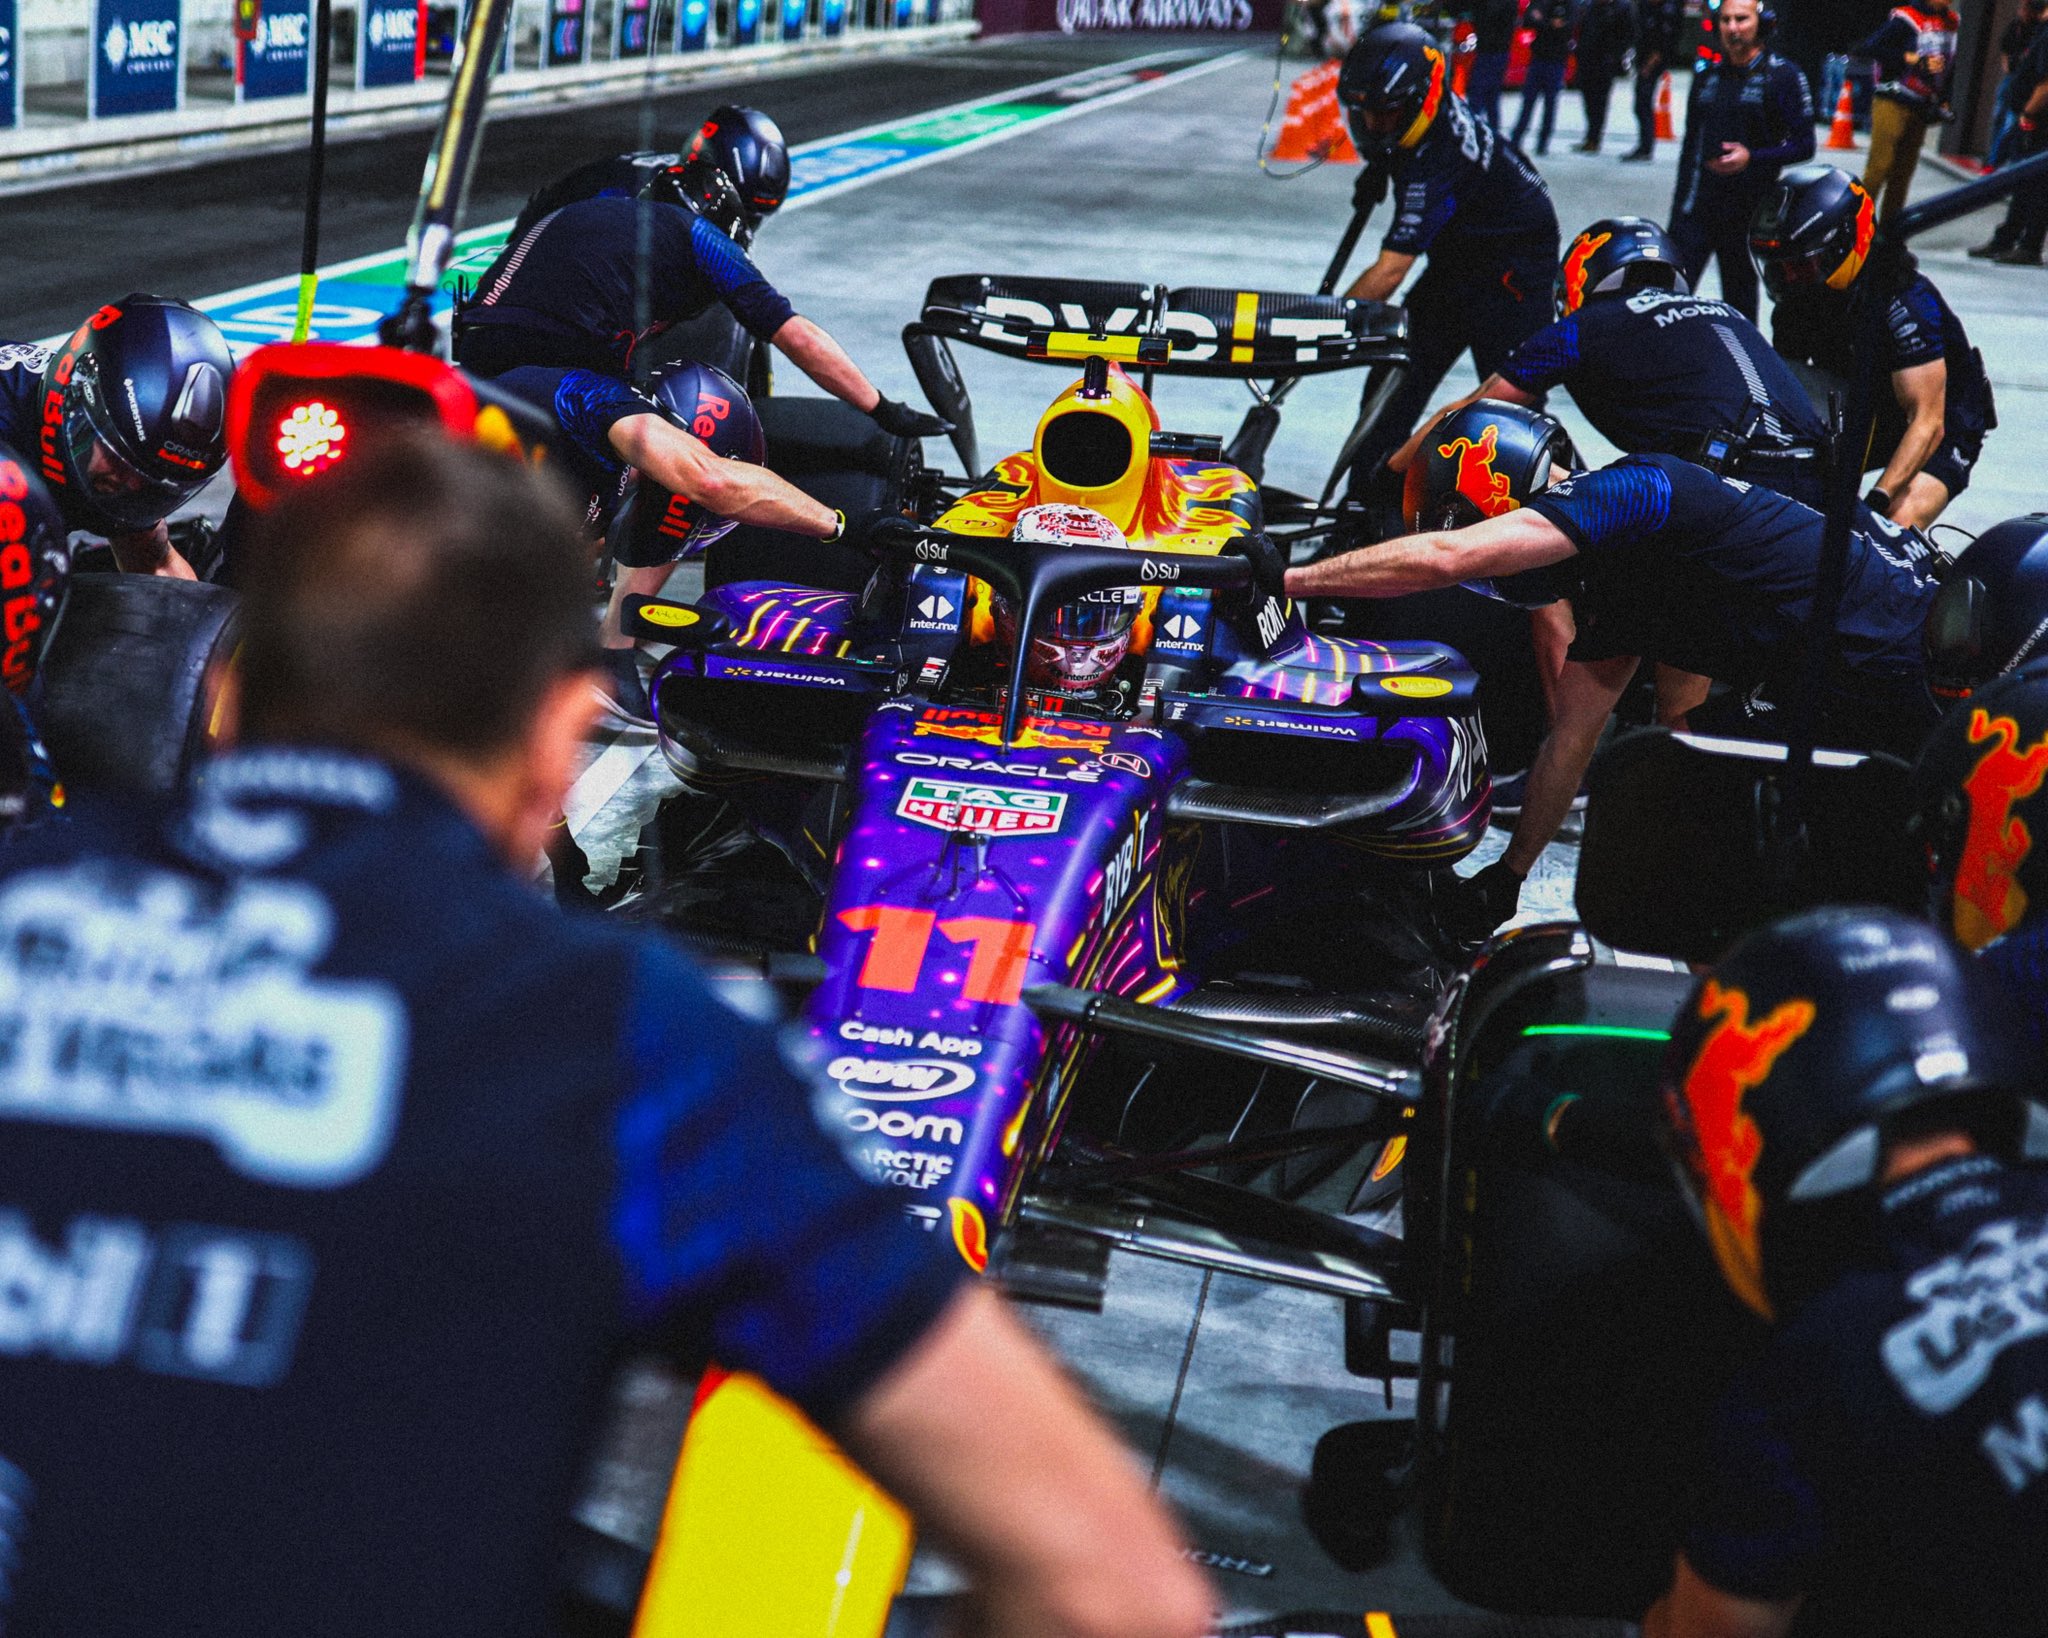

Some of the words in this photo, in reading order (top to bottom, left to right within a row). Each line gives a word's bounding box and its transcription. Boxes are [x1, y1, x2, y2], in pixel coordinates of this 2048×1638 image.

[128, 20, 176, 58] MSC
[1652, 302, 1730, 329] Mobil
[126, 385, 147, 443] POKERSTARS
[692, 392, 731, 450] Re
[657, 493, 693, 539] ull
[929, 544, 950, 561] Sui
[1158, 563, 1180, 580] Sui
[909, 618, 959, 634] inter.mx
[1155, 638, 1205, 652] inter.mx
[753, 668, 846, 687] Walmart
[1256, 718, 1357, 737] Walmart
[895, 752, 1101, 783] ORACLE
[921, 783, 1052, 807] TAG
[908, 800, 1052, 830] HEUER
[1103, 809, 1149, 929] BYBIT
[836, 903, 1037, 1007] 11
[840, 1020, 914, 1047] Cash
[917, 1031, 983, 1057] App
[842, 1107, 964, 1145] oom
